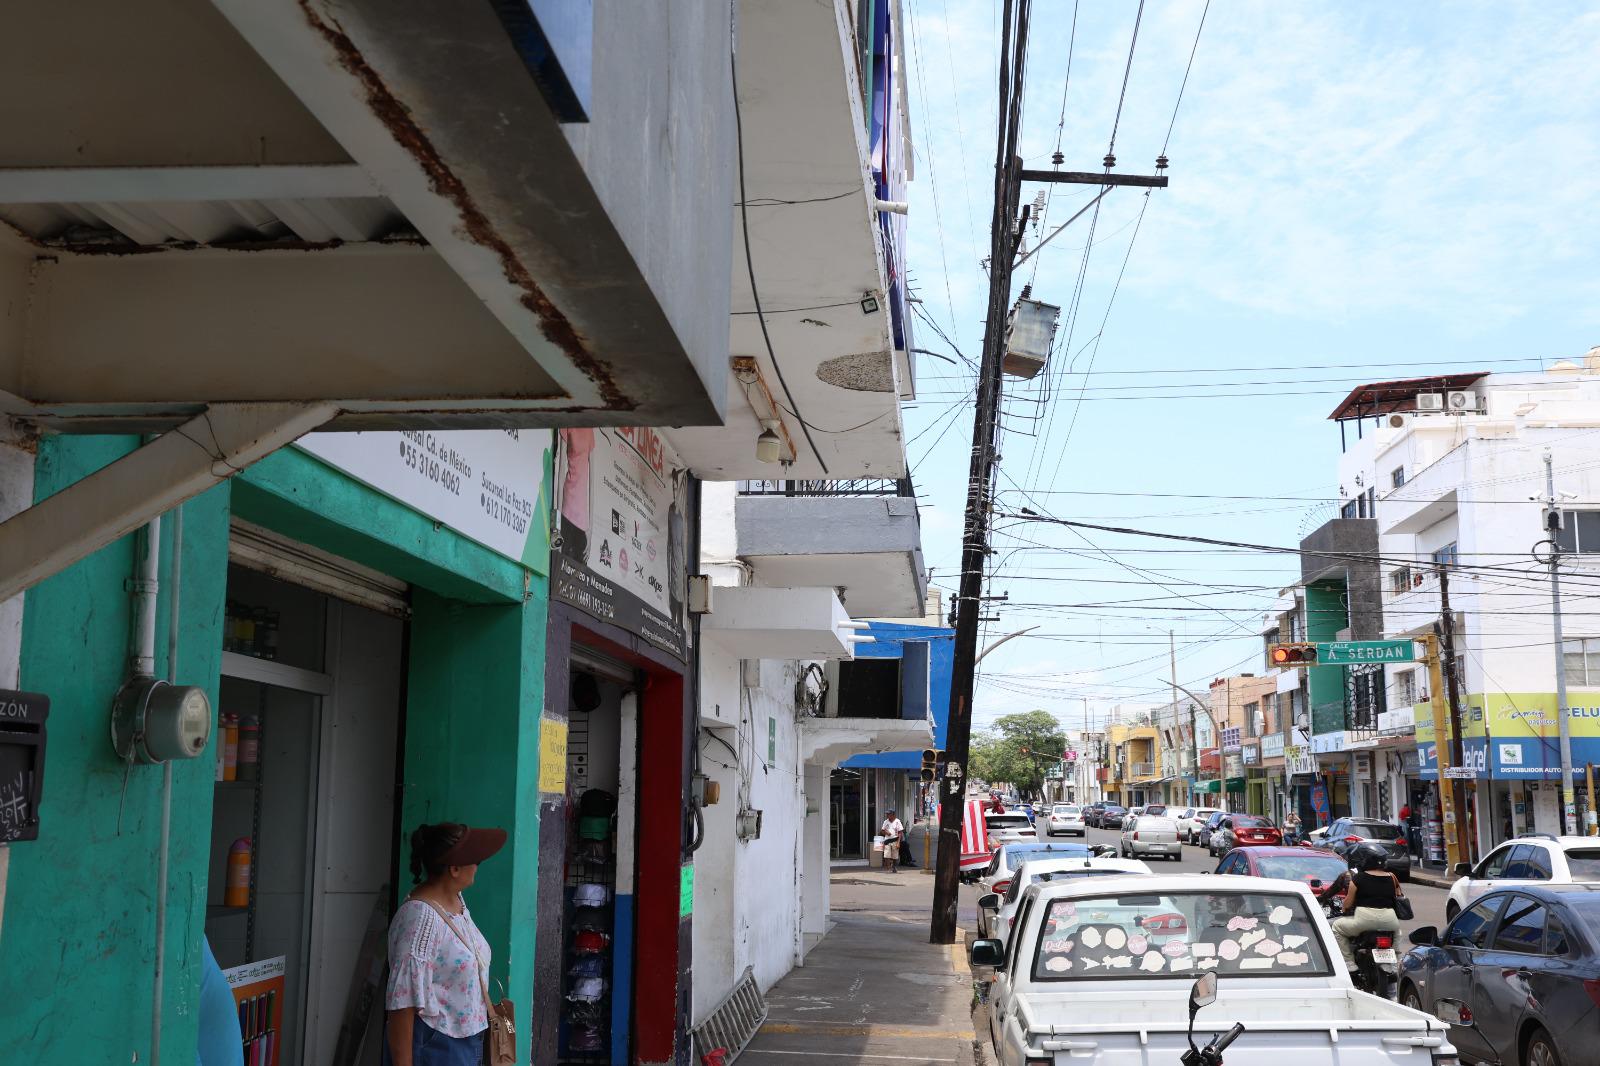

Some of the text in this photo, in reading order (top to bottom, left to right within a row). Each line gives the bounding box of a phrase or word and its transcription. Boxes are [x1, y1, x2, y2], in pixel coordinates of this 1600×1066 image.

[405, 444, 461, 497] 55 3160 4062
[426, 433, 438, 455] Cd.
[439, 443, 448, 462] de
[449, 449, 472, 479] México
[481, 471, 505, 501] Sucursal
[522, 498, 533, 519] BCS
[486, 496, 528, 535] 612 170 3367
[1328, 646, 1404, 661] A. SERDAN
